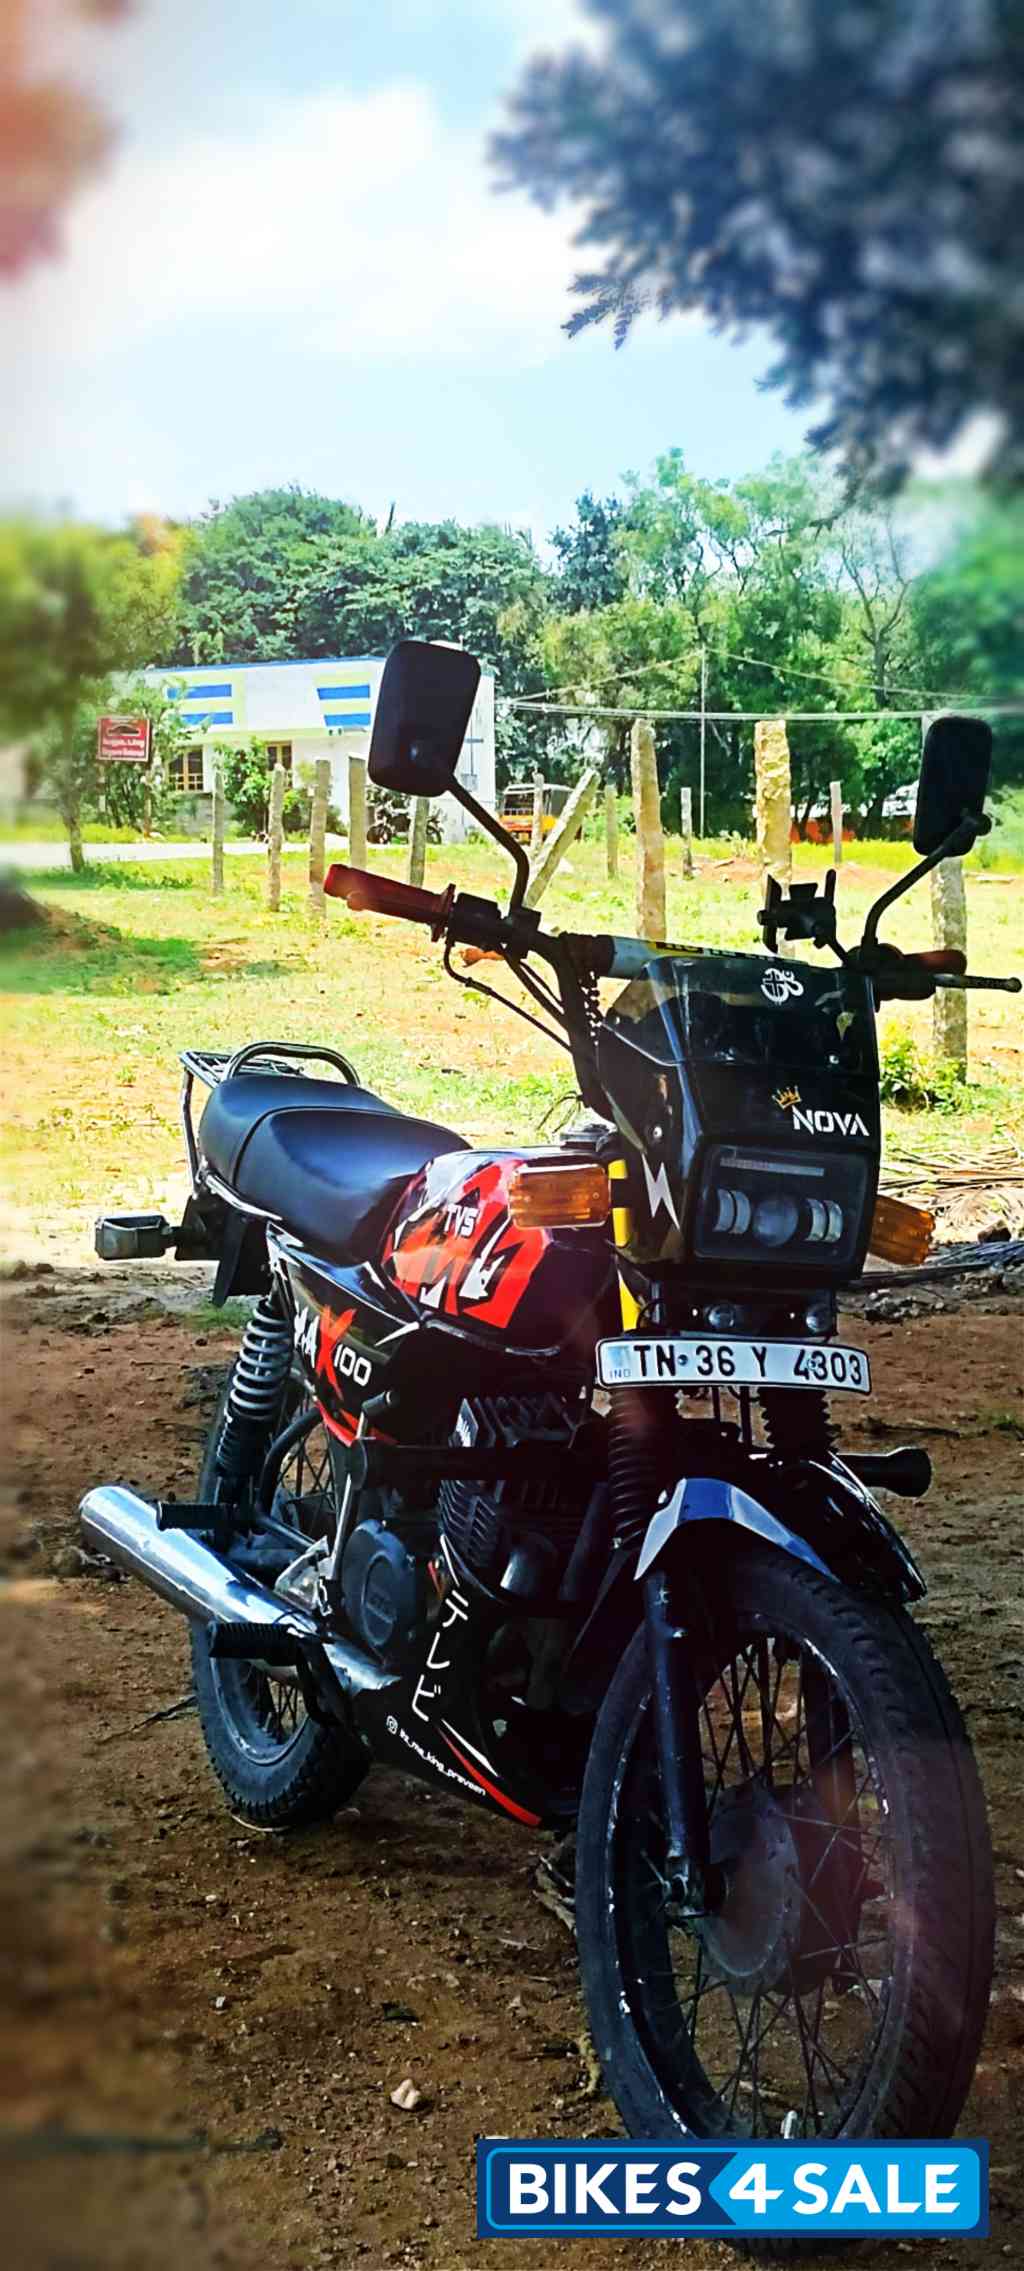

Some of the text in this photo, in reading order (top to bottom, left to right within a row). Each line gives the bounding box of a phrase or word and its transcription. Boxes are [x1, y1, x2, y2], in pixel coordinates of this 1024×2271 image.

[792, 1105, 870, 1137] NOVA
[444, 1203, 480, 1238] TVS
[634, 1345, 862, 1385] TN 36 Y 4303
